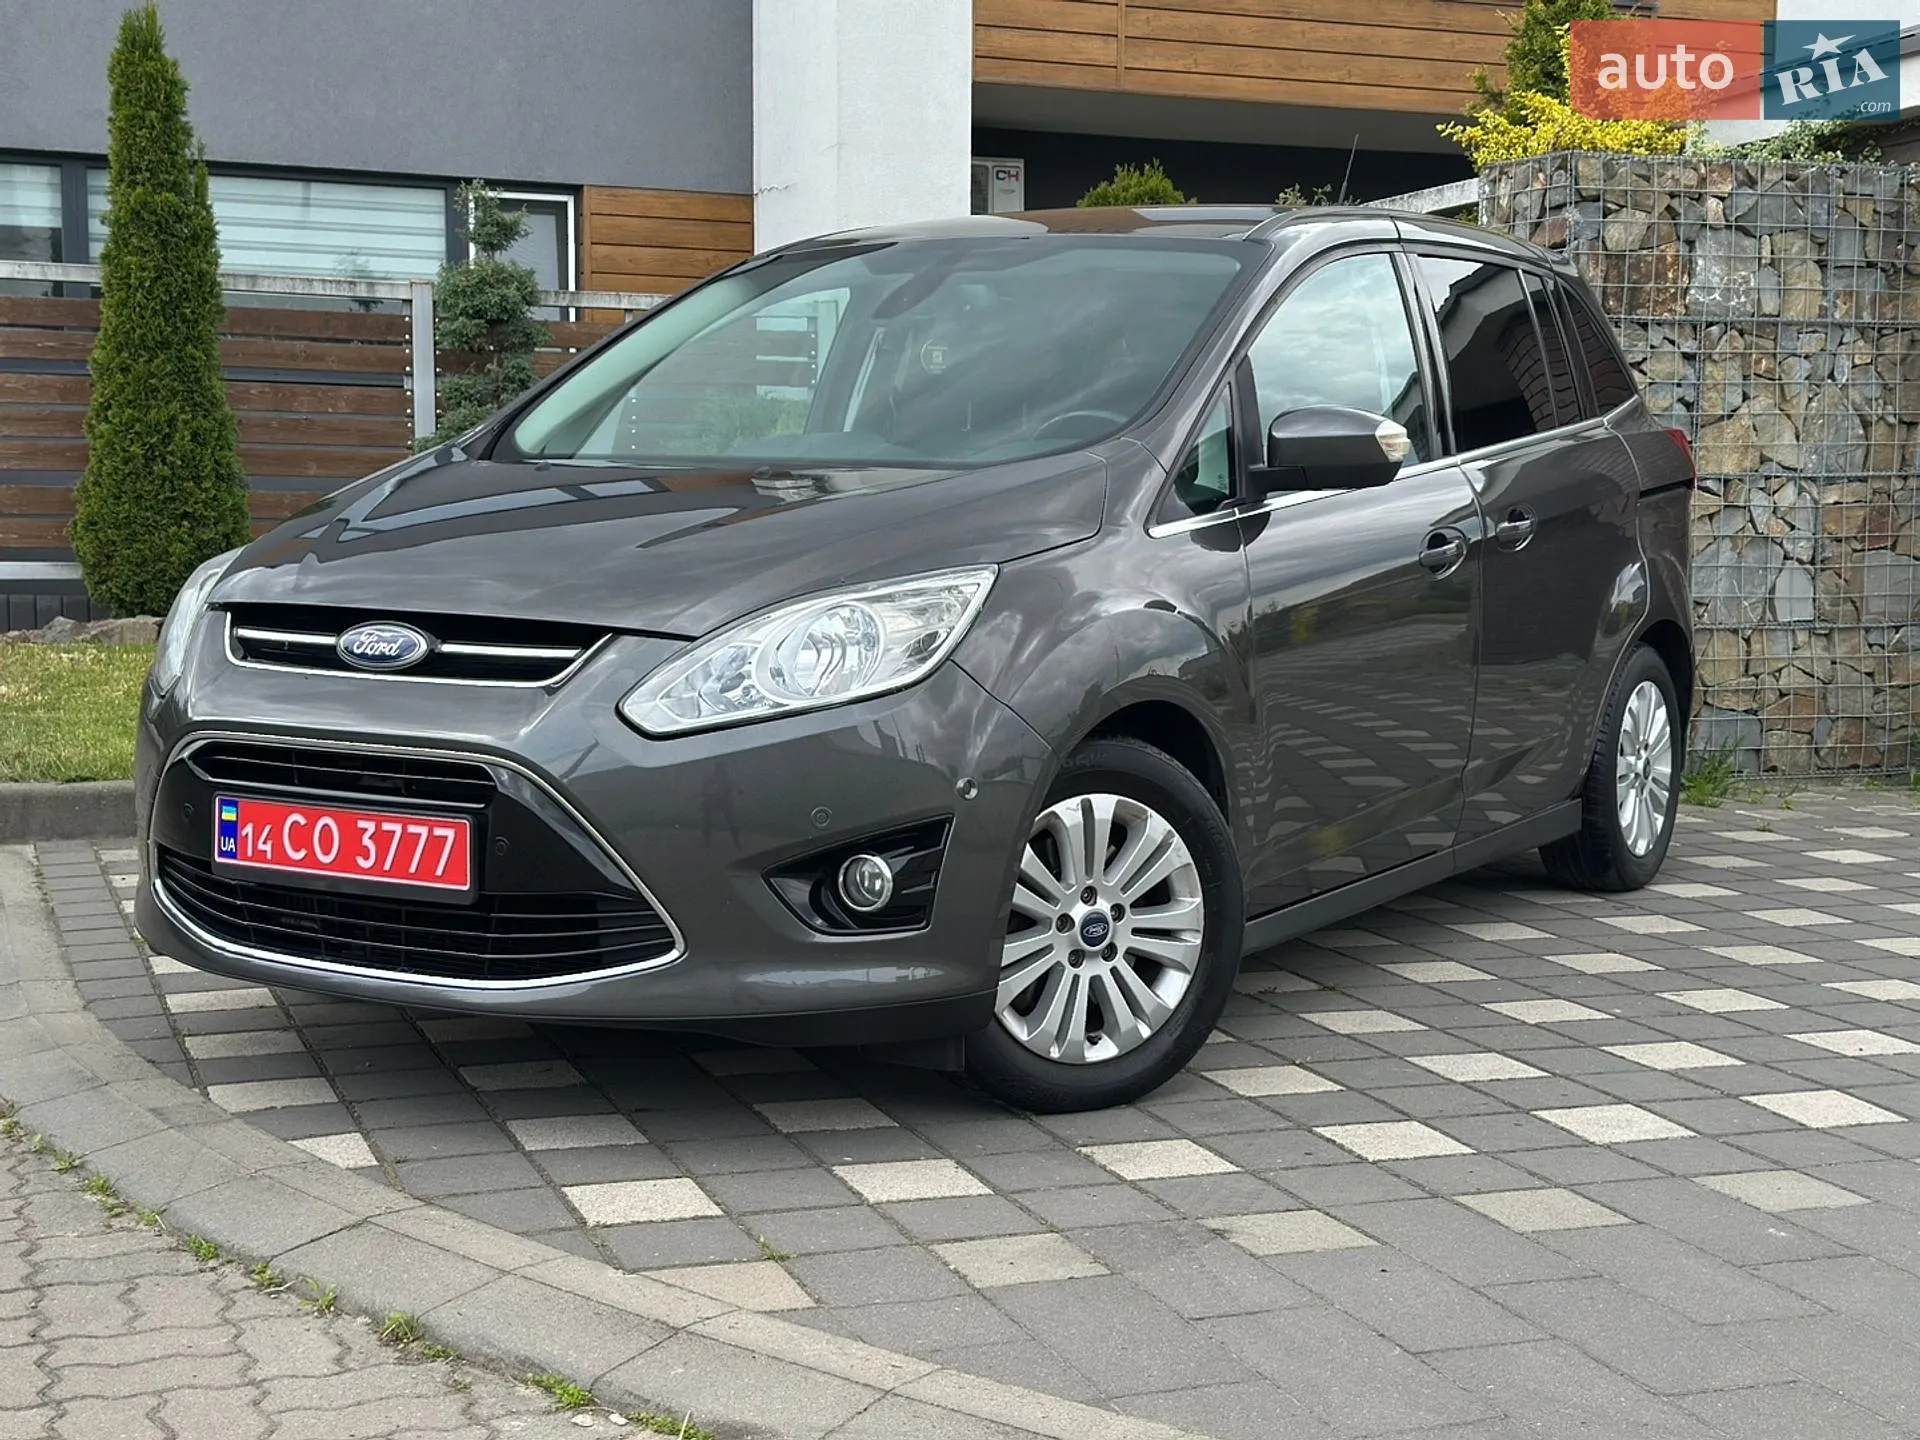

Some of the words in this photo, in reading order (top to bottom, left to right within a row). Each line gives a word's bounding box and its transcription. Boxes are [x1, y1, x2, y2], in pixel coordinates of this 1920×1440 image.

[353, 629, 404, 656] Ford
[220, 835, 236, 852] UA
[241, 822, 273, 860] 14
[282, 812, 340, 864] CO
[355, 818, 456, 877] 3777
